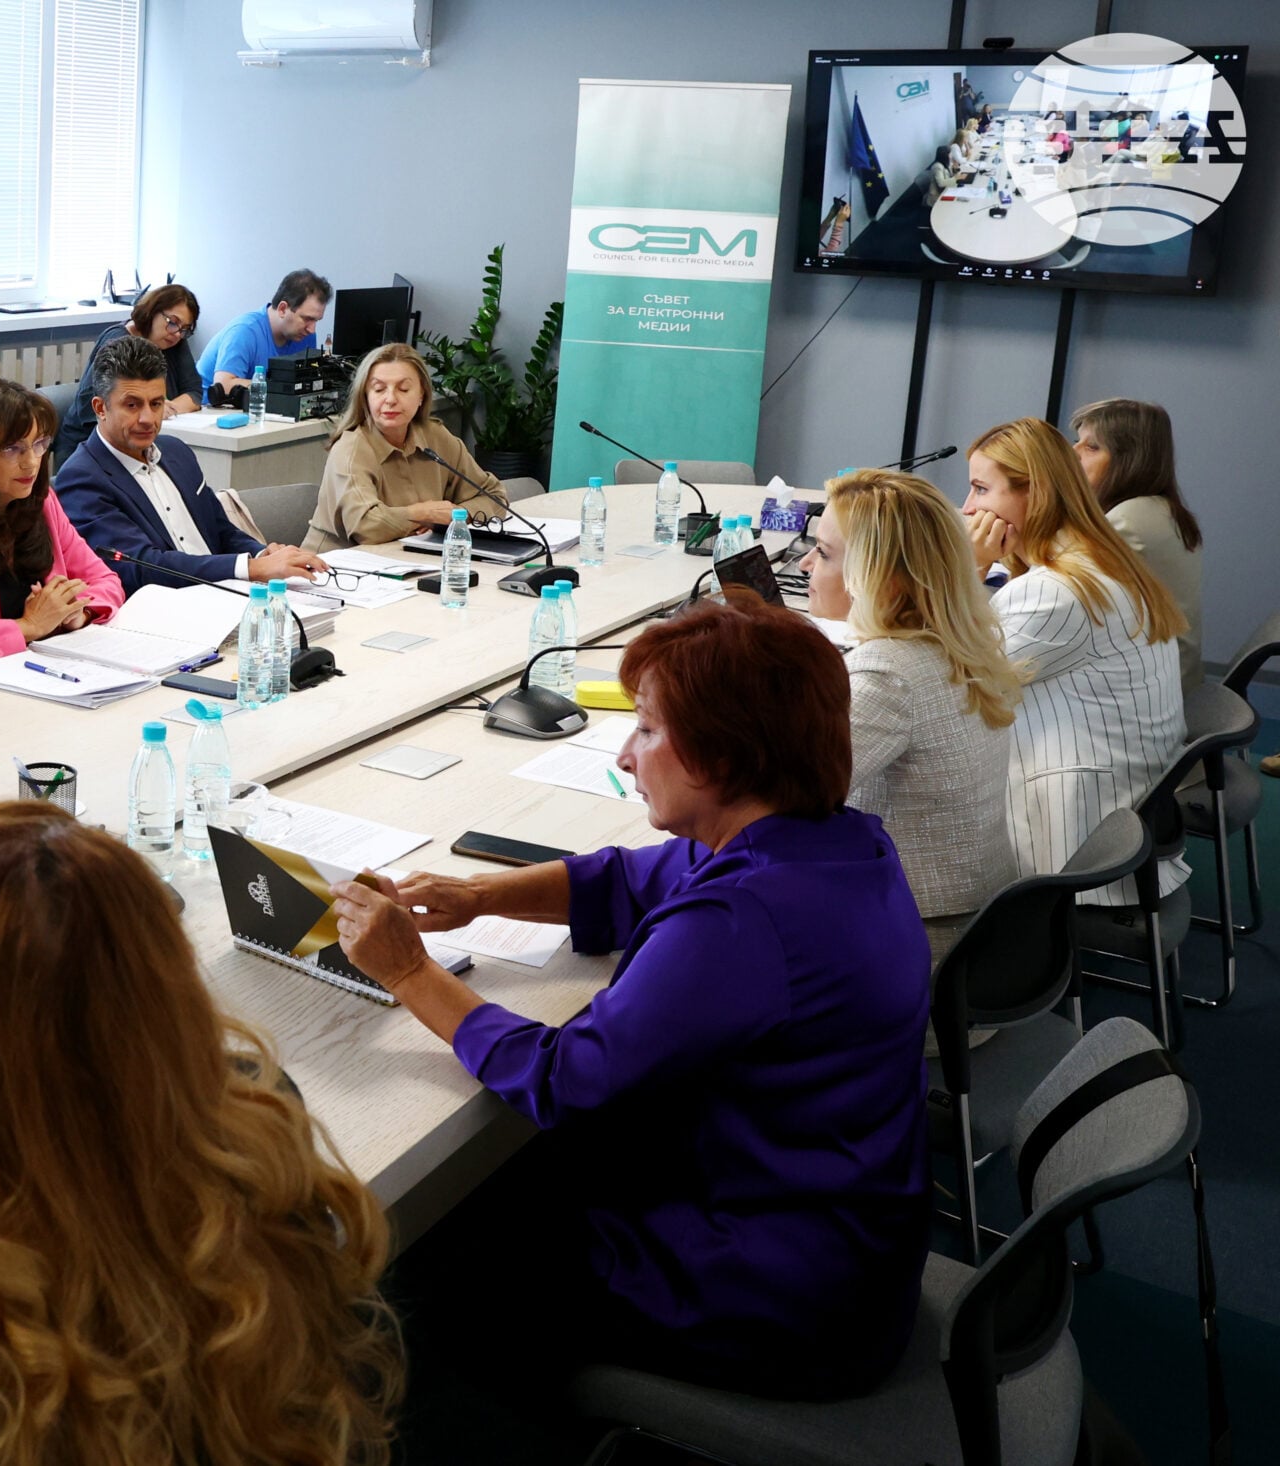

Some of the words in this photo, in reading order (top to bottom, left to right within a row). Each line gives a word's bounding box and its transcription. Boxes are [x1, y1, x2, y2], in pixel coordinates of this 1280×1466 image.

[592, 253, 635, 262] COUNCIL
[660, 256, 721, 265] ELECTRONIC
[723, 259, 755, 267] MEDIA
[643, 294, 691, 305] СЪВЕТ
[607, 306, 625, 315] ЗА
[628, 306, 725, 321] ЕЛЕКТРОННИ
[638, 321, 691, 333] МЕДИИ
